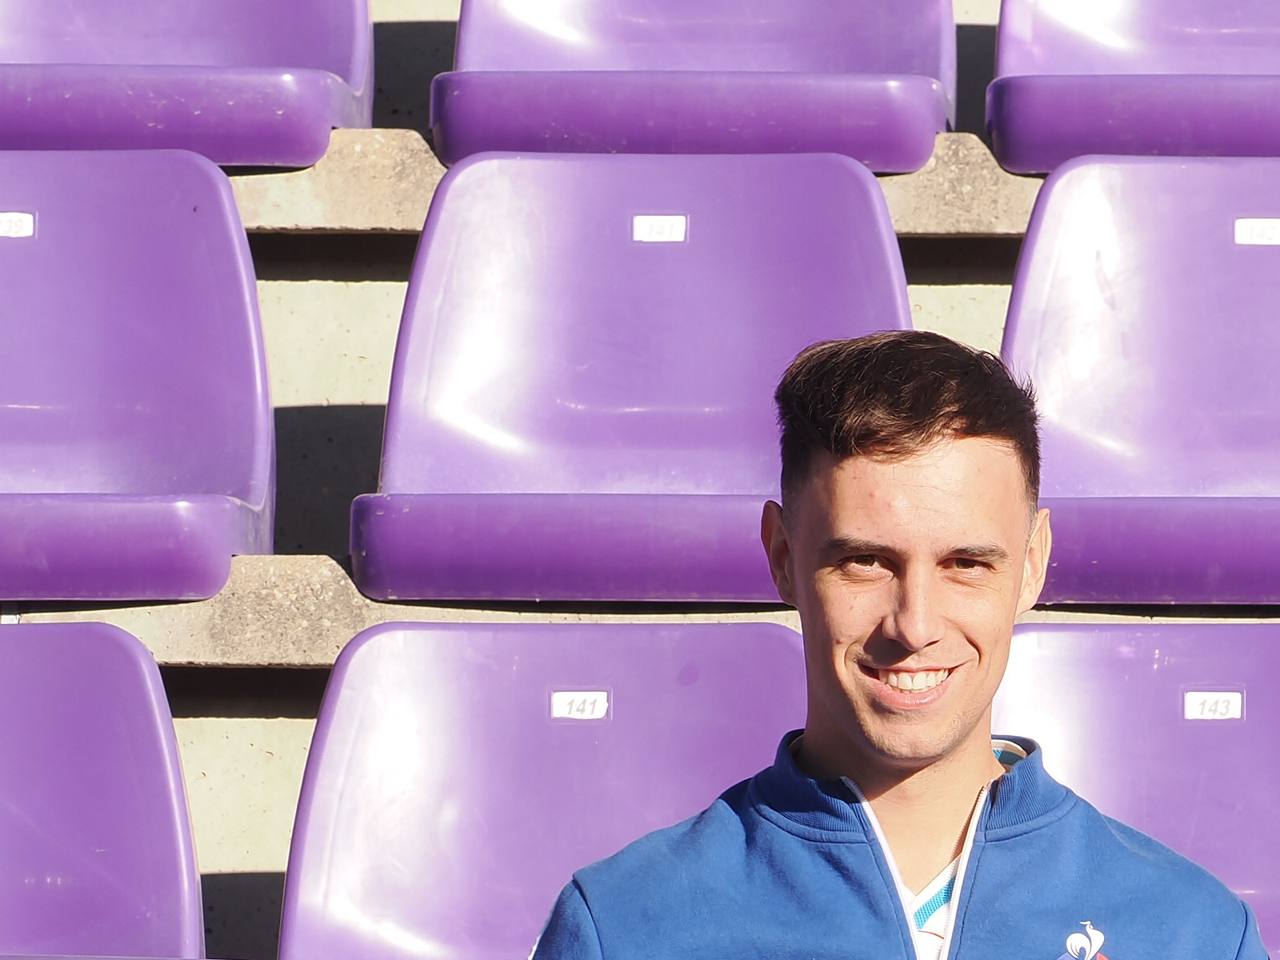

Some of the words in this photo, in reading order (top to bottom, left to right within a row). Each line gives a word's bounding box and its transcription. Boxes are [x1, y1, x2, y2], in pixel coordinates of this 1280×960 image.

[0, 217, 24, 235] 39
[567, 698, 597, 715] 141
[1198, 699, 1231, 716] 143
